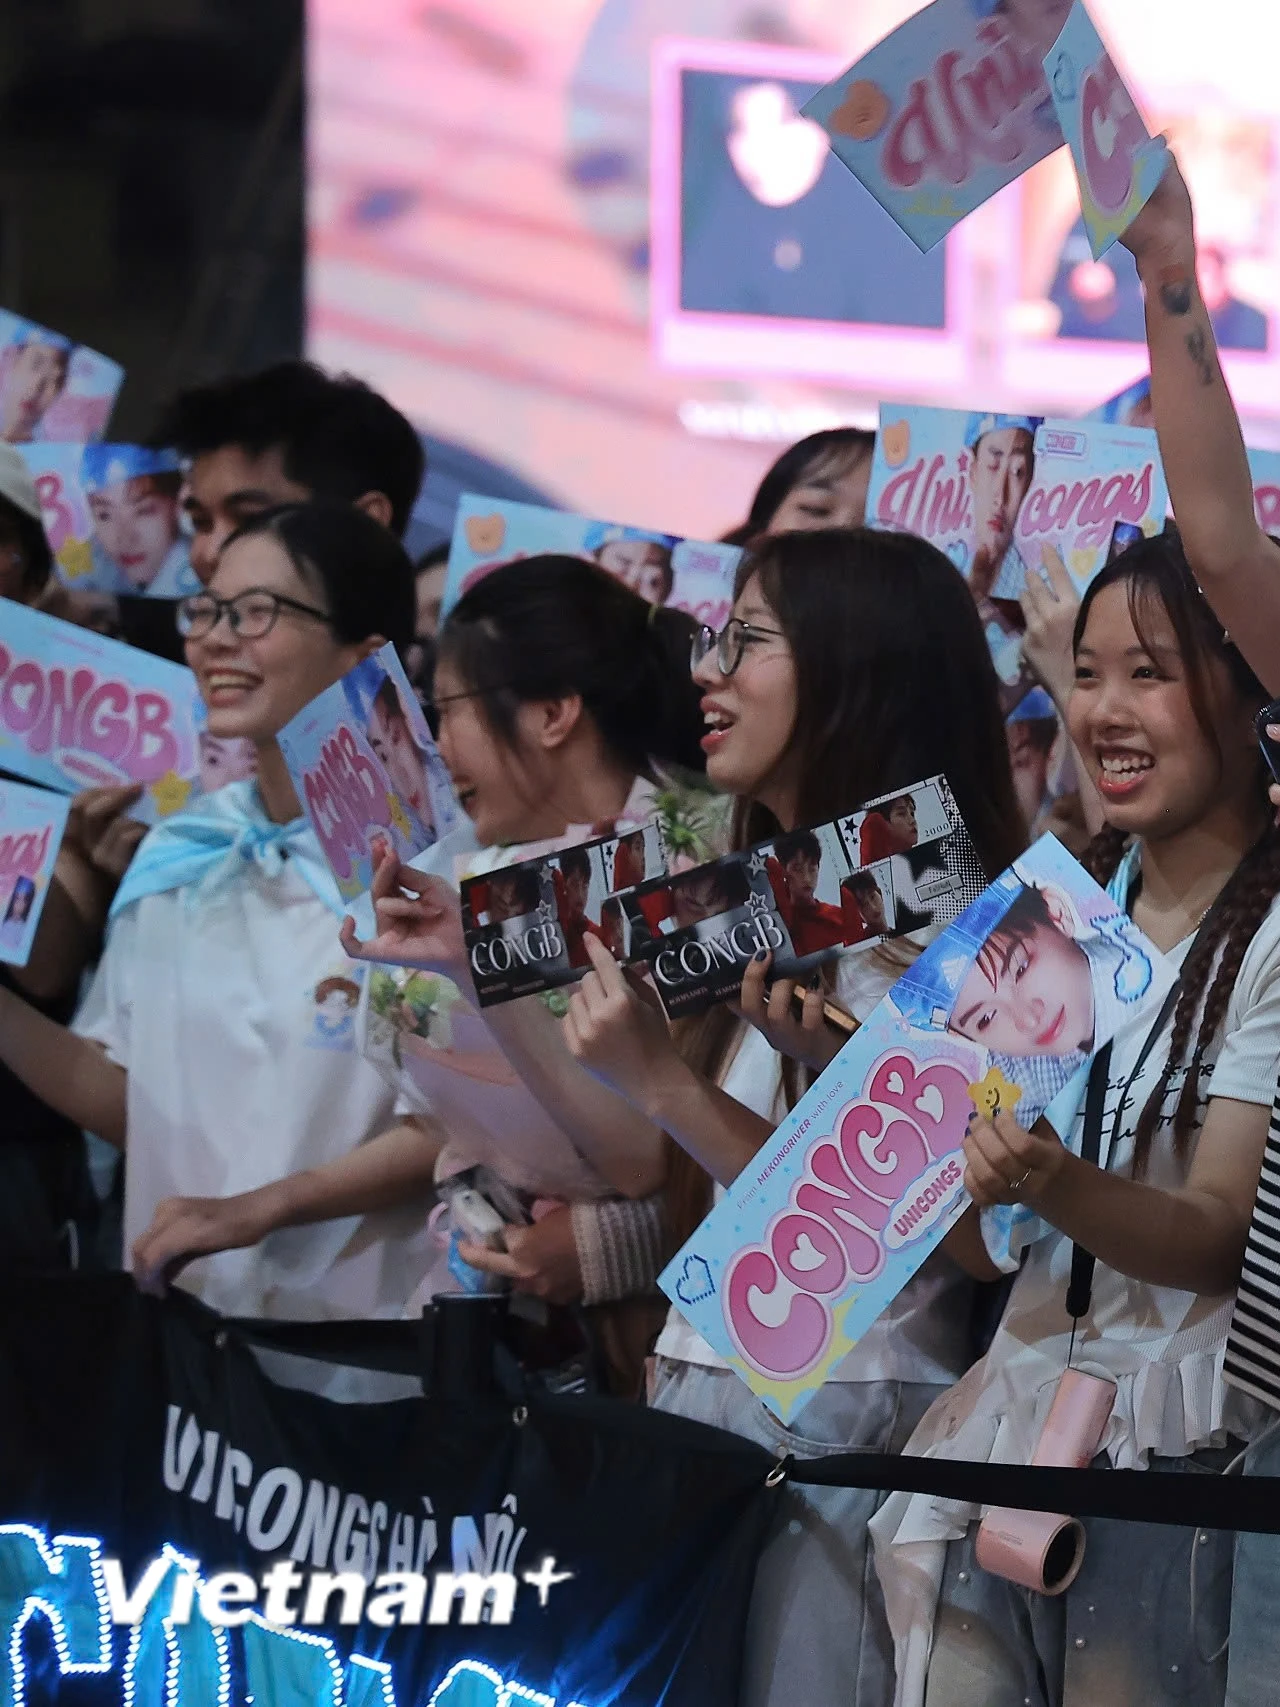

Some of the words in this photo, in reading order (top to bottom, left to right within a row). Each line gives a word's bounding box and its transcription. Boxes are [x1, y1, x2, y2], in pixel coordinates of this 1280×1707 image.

[0, 645, 178, 784] ONGB
[925, 822, 950, 838] 2000
[471, 922, 562, 976] CONGB
[655, 913, 783, 986] CONGB
[757, 1119, 812, 1186] MEKONGRIVER
[810, 1099, 829, 1120] with
[826, 1081, 844, 1101] love
[728, 1054, 980, 1373] CONGB
[893, 1160, 962, 1237] UNICONGS
